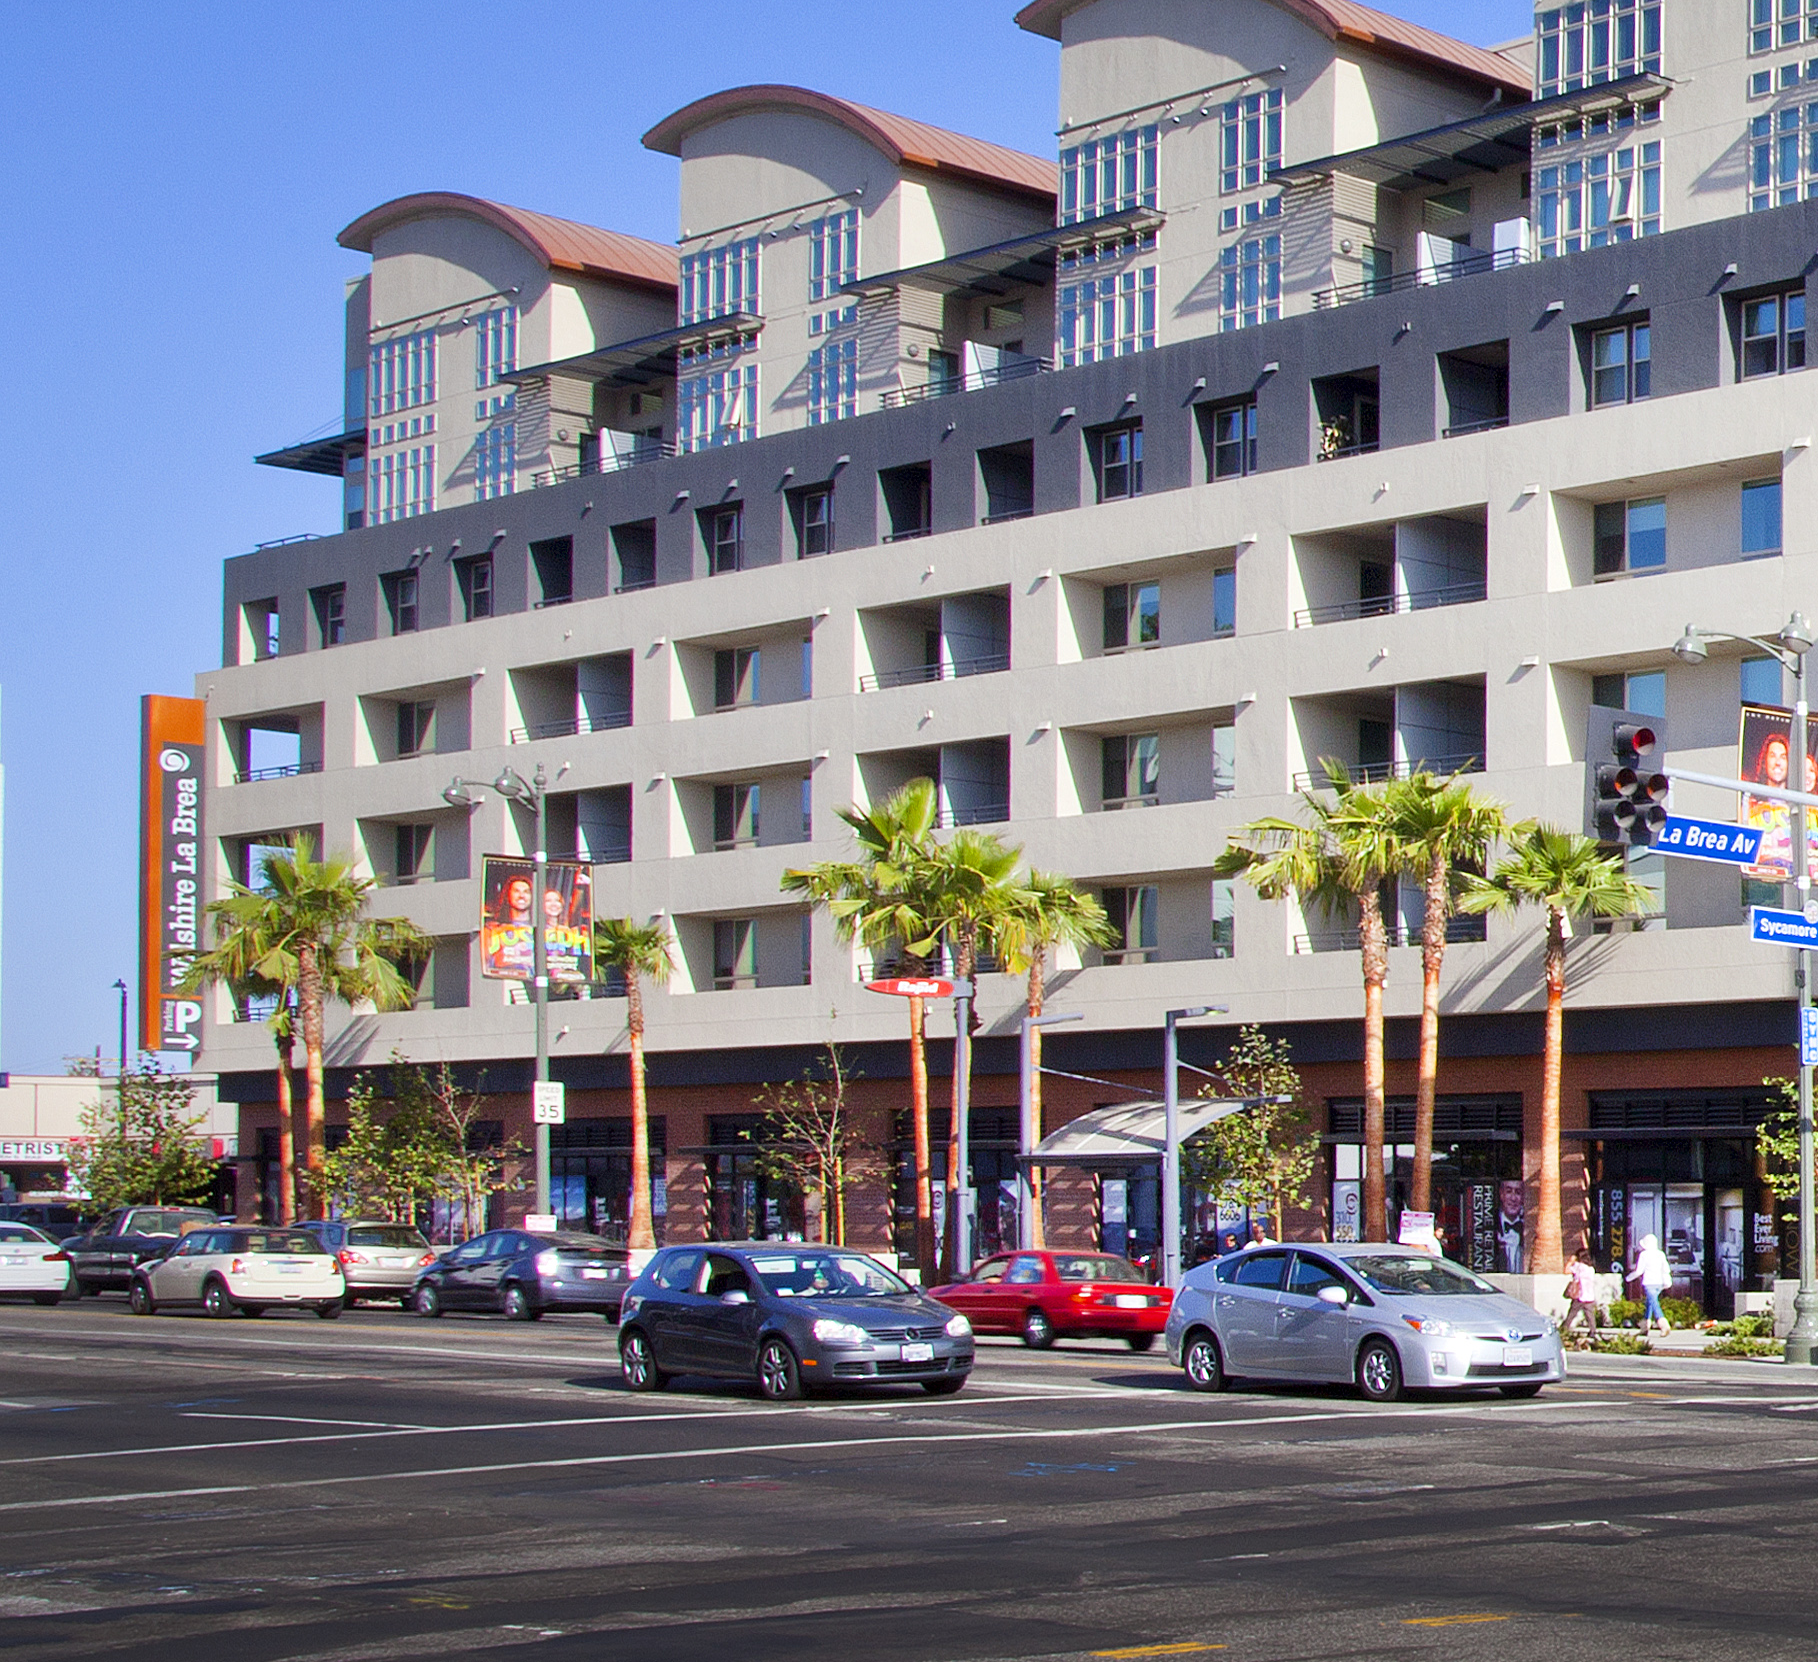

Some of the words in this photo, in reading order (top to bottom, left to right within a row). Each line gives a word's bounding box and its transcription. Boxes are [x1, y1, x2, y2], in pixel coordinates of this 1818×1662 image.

[172, 777, 198, 836] Brea
[1658, 826, 1682, 844] La
[1685, 825, 1727, 852] Brea
[1730, 833, 1756, 854] Av
[170, 841, 197, 874] La
[1760, 917, 1818, 939] Sycamore
[176, 1001, 202, 1033] P
[537, 1085, 561, 1093] SPEED
[538, 1104, 559, 1118] 35
[1483, 1184, 1494, 1228] PRIME
[1483, 1230, 1494, 1273] RETAIL
